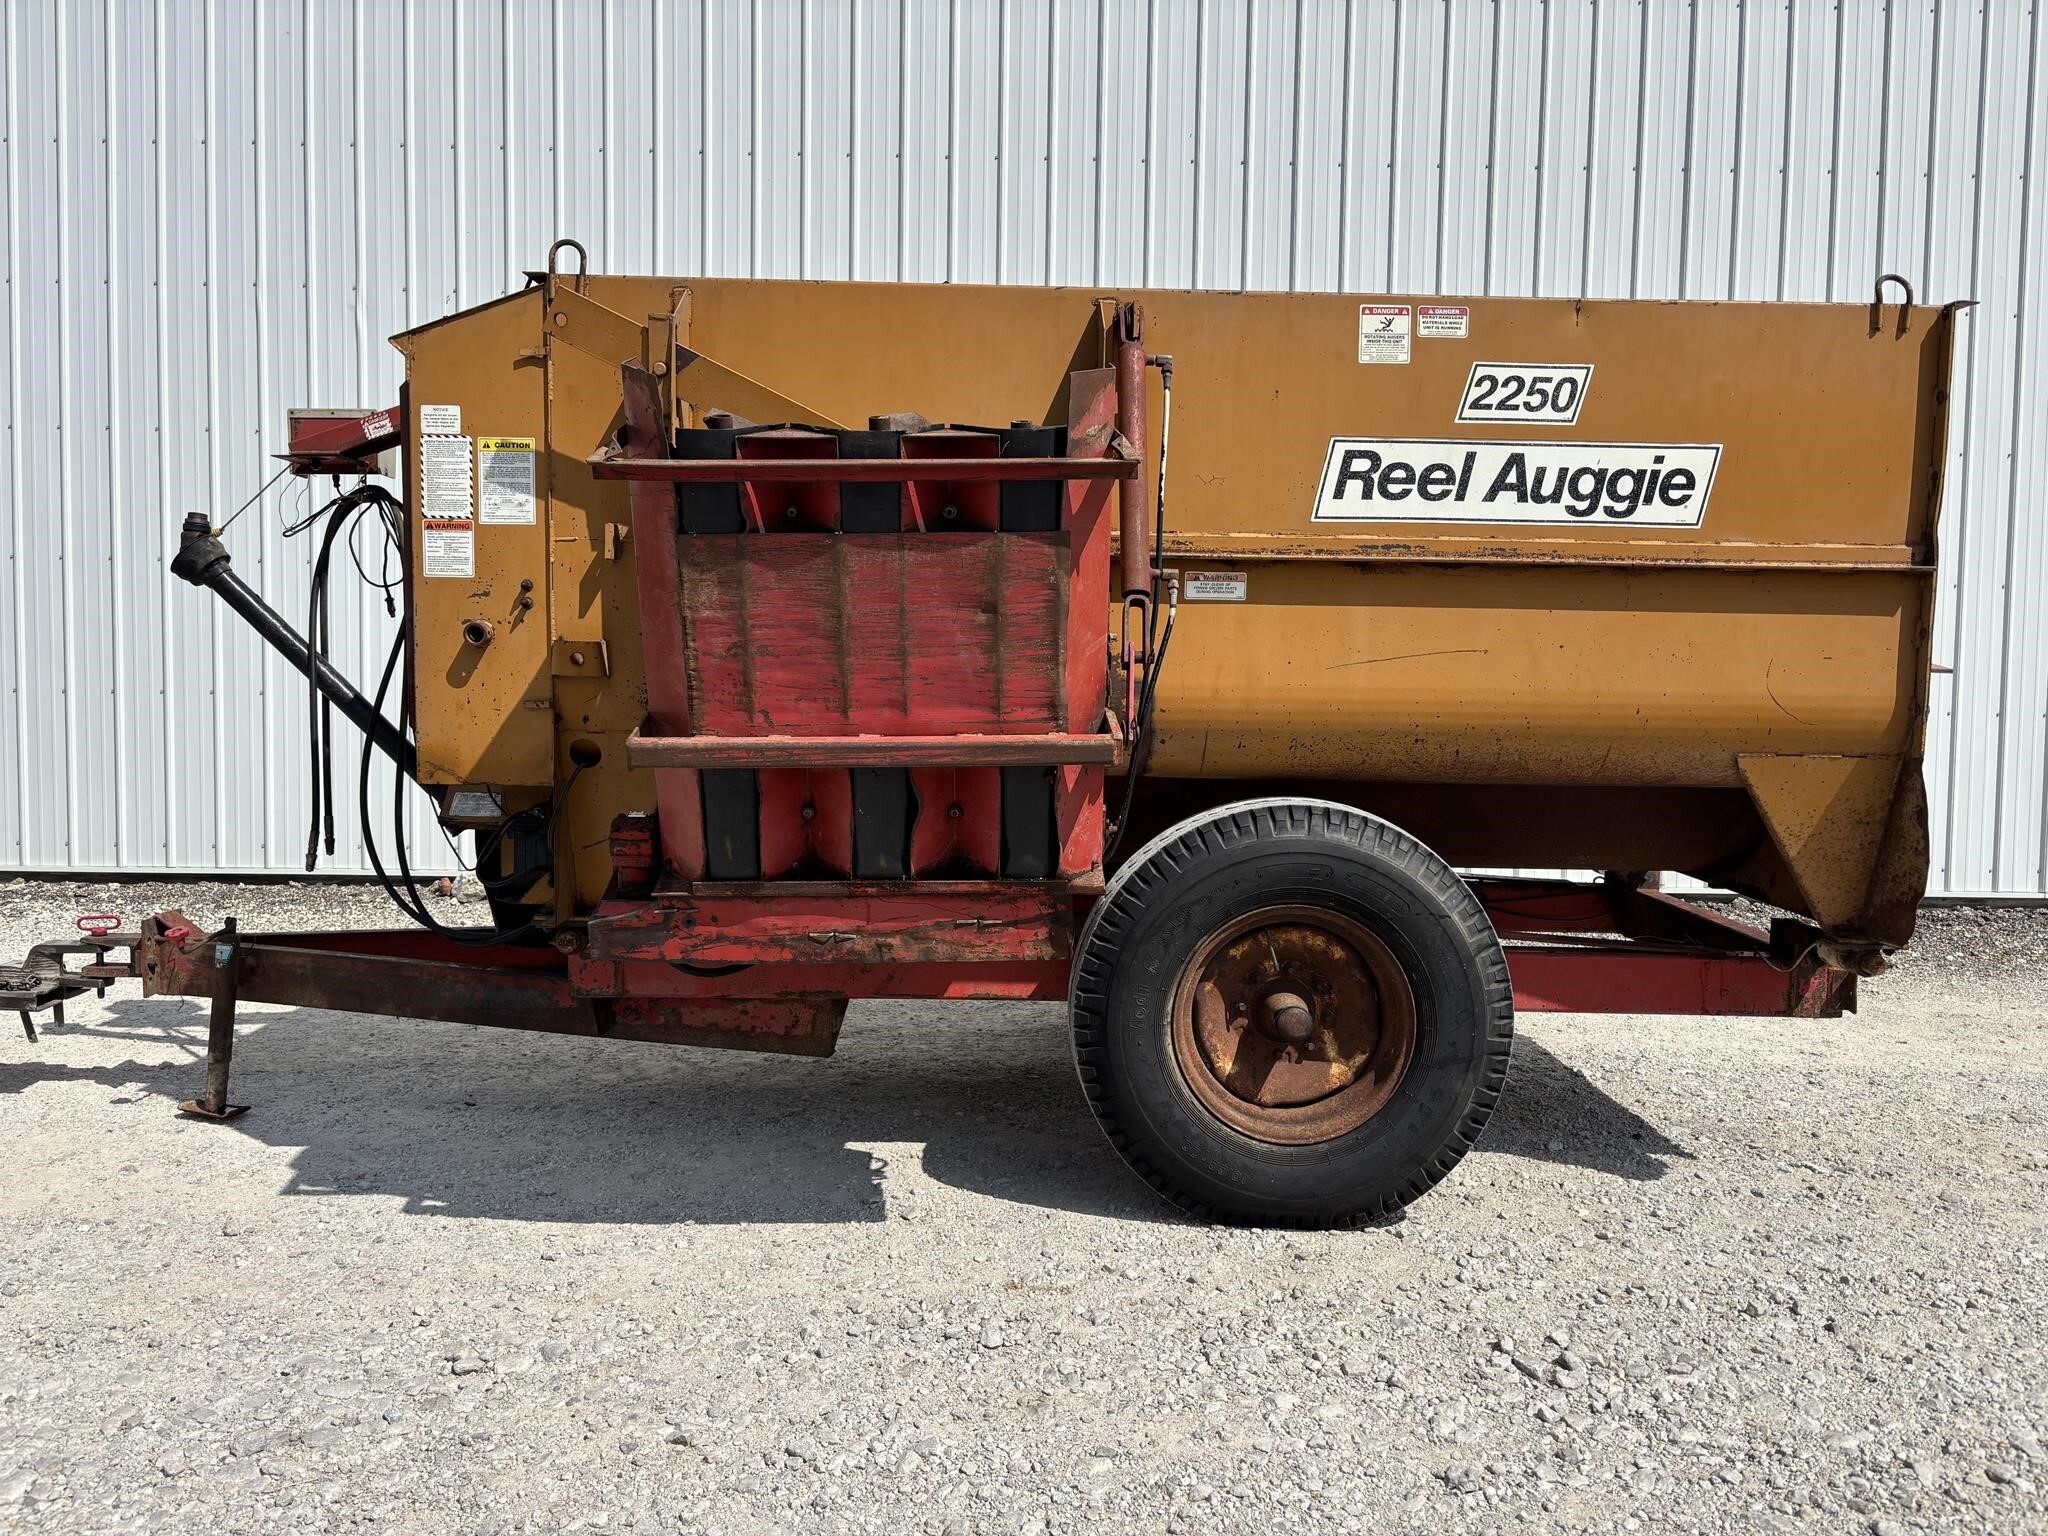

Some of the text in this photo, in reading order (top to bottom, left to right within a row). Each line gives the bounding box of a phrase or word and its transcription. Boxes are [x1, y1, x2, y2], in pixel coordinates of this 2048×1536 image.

[1467, 374, 1579, 413] 2250
[494, 441, 531, 449] CAUTION
[1332, 449, 1697, 519] Reel Auggie
[434, 521, 470, 531] WARNING
